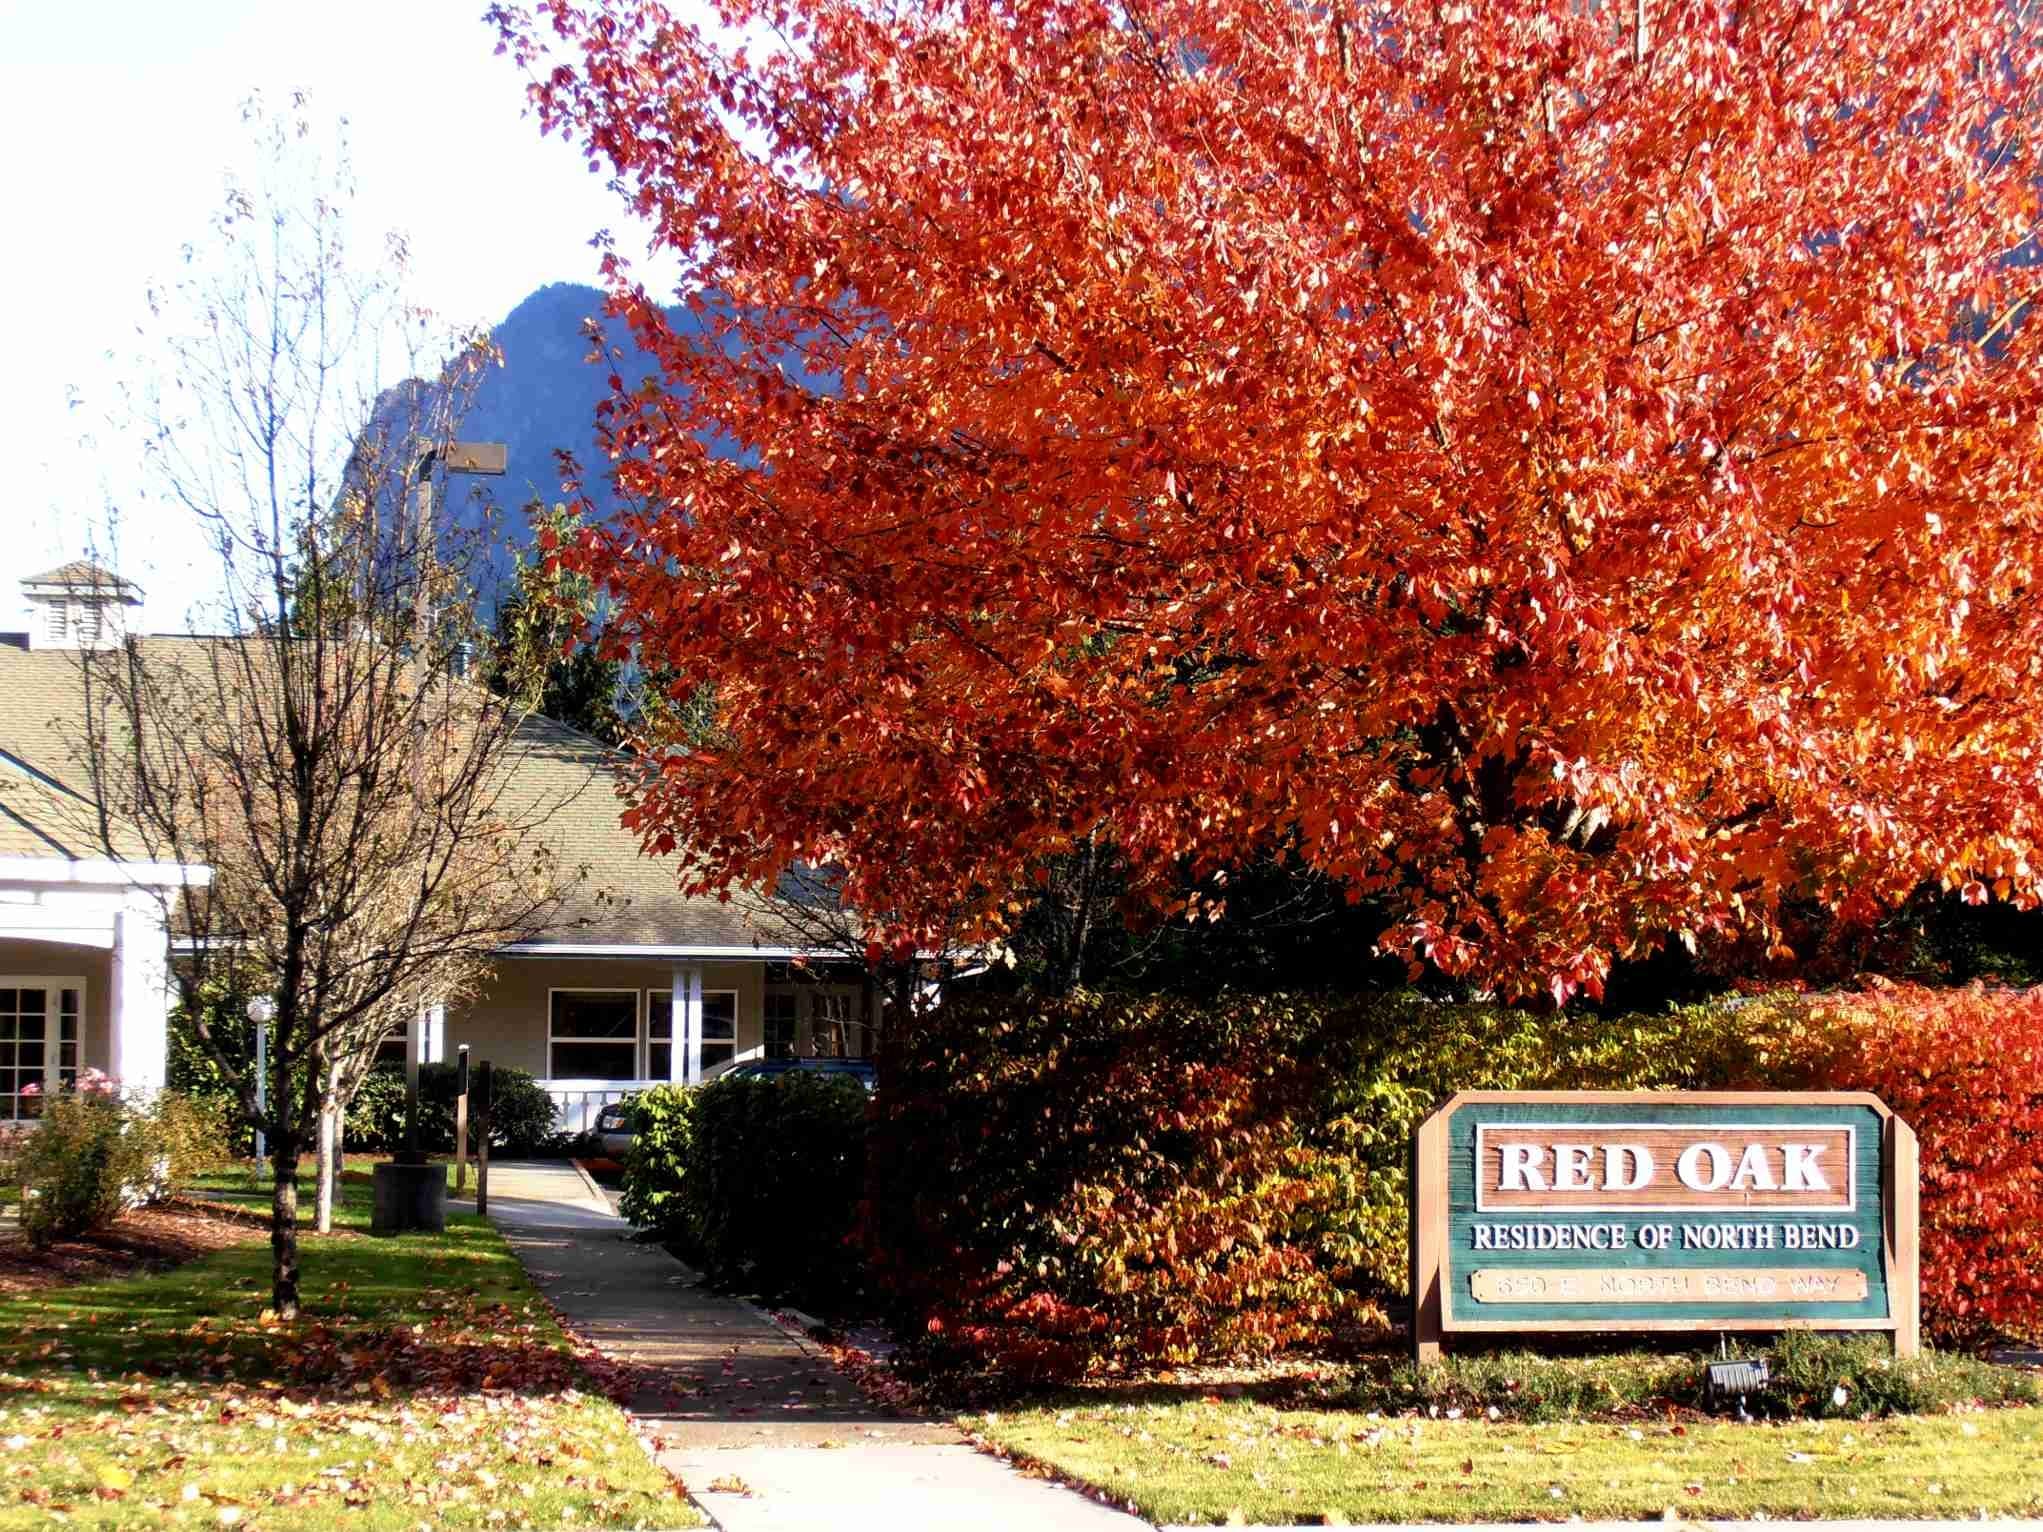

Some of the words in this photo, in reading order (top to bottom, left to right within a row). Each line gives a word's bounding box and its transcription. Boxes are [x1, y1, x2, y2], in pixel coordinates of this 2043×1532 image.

[1496, 1143, 1655, 1192] RED
[1677, 1142, 1831, 1192] OAK
[1472, 1223, 1627, 1250] RESIDENCE
[1638, 1223, 1674, 1250] OF
[1682, 1223, 1775, 1250] NORTH
[1784, 1223, 1861, 1250] BEND
[1599, 1275, 1689, 1295] NORTH
[1705, 1275, 1777, 1296] BEND
[1790, 1274, 1842, 1294] WAY
